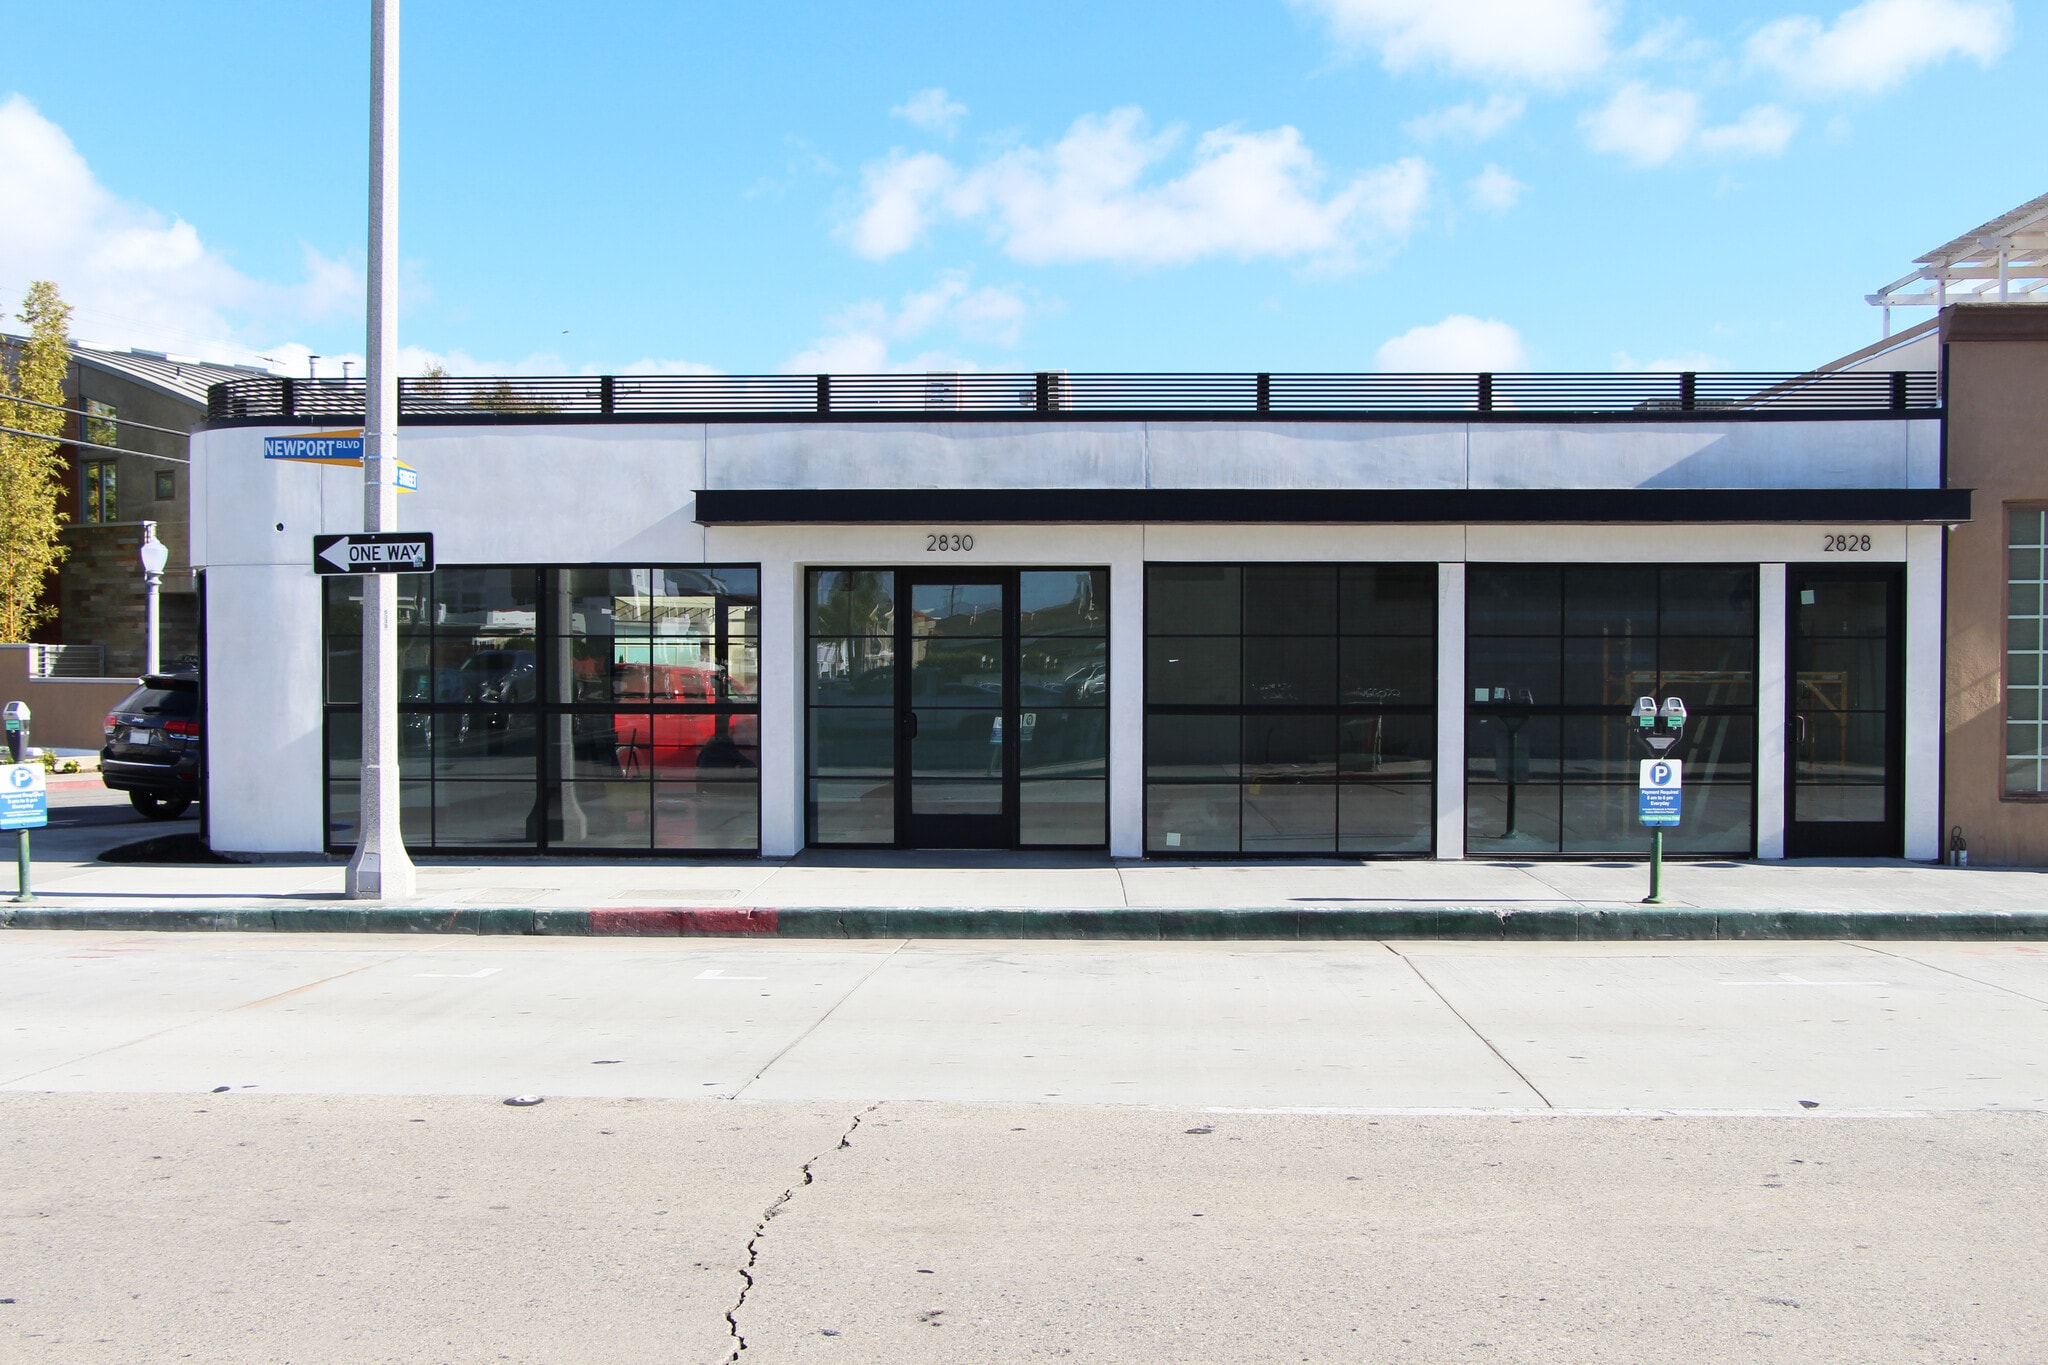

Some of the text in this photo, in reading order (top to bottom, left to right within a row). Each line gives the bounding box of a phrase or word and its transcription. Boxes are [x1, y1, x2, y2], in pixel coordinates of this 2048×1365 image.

[264, 440, 360, 456] NEWPORT BLVD
[926, 534, 974, 551] 2830
[1823, 534, 1871, 551] 2828
[349, 545, 421, 562] ONE WAY
[15, 769, 30, 787] P
[1655, 765, 1668, 782] P
